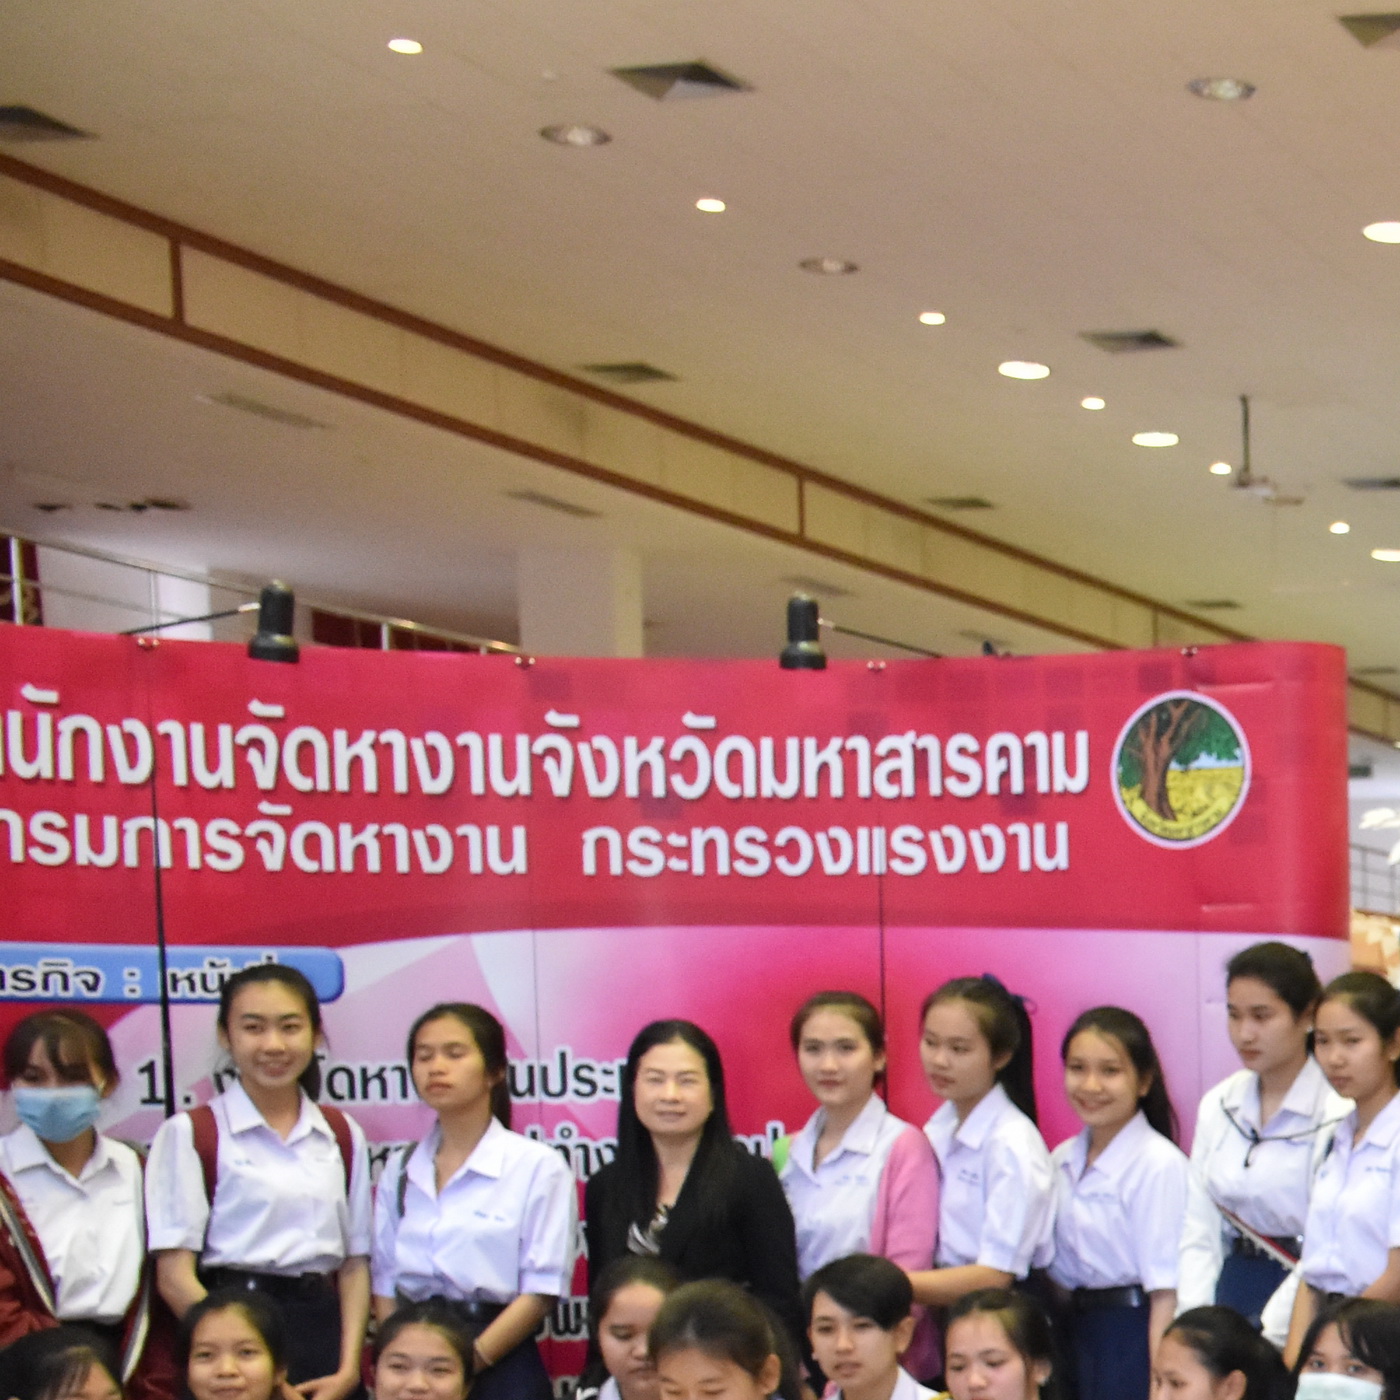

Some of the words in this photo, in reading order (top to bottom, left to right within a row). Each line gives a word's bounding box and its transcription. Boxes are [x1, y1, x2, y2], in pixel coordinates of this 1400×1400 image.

[0, 682, 1089, 800] นักงานจัดหางานจังหวัดมหาสารคาม
[582, 821, 1069, 878] กระทรวงแรงงาน
[0, 961, 102, 993] รกิจ
